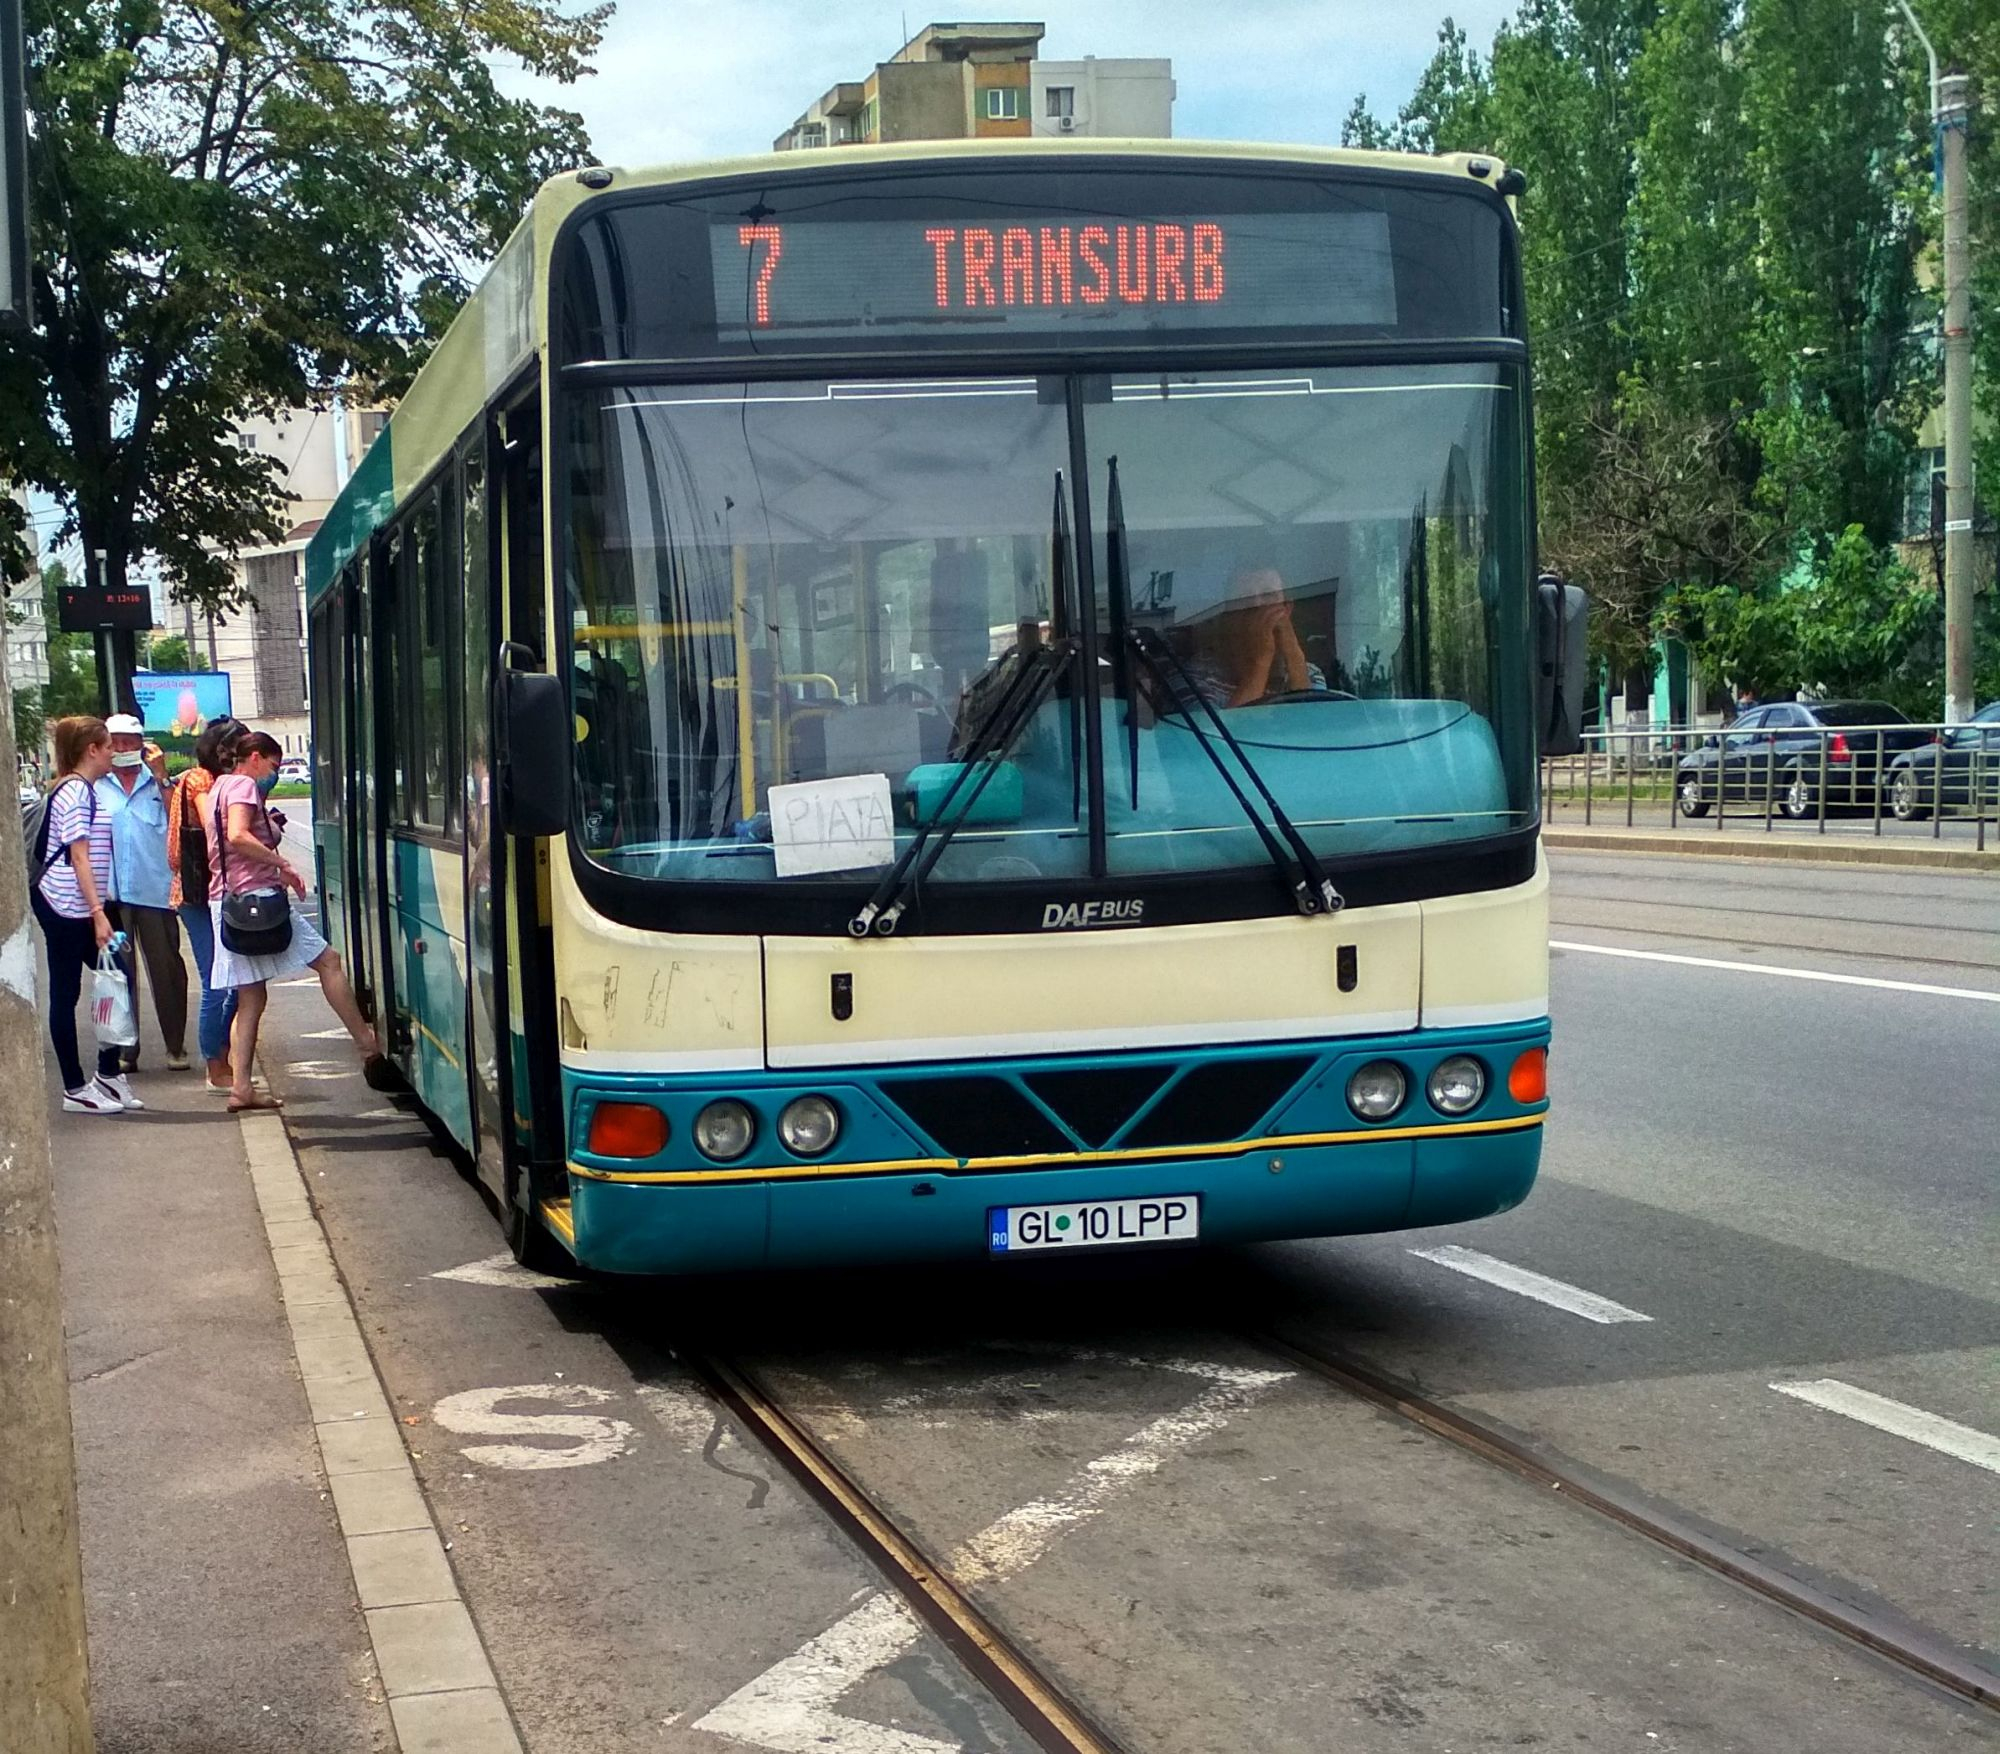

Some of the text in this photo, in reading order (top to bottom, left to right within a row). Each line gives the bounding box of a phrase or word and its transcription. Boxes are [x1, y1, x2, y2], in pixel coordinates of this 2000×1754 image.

[738, 223, 1225, 325] 7 TRANSURB
[992, 1232, 1008, 1247] RO
[1018, 1202, 1187, 1244] GL 10 LPP
